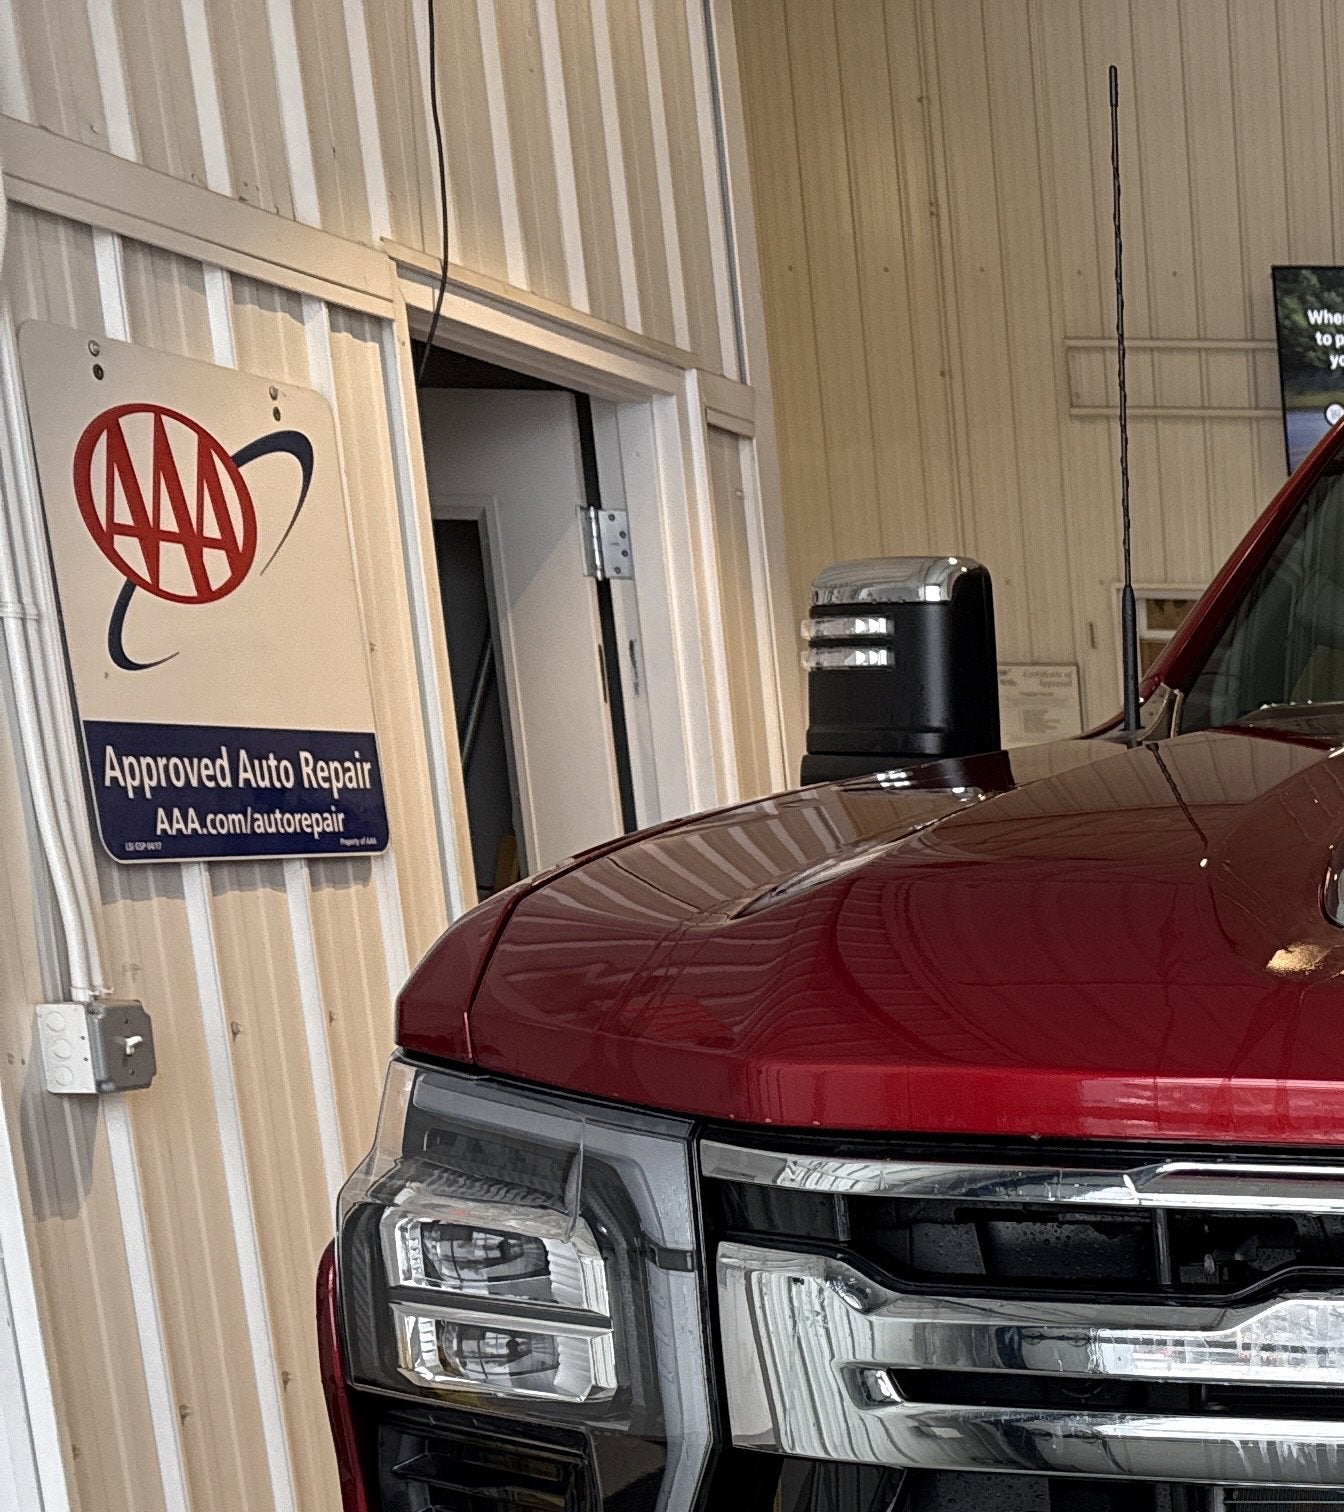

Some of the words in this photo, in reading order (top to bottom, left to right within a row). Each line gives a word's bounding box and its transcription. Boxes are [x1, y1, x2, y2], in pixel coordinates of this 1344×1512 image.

[1315, 331, 1332, 346] to
[102, 406, 251, 601] AAA
[104, 745, 233, 799] Approved
[238, 749, 295, 789] Auto
[299, 750, 372, 799] Repair
[156, 806, 345, 839] AAA.com/autorepair
